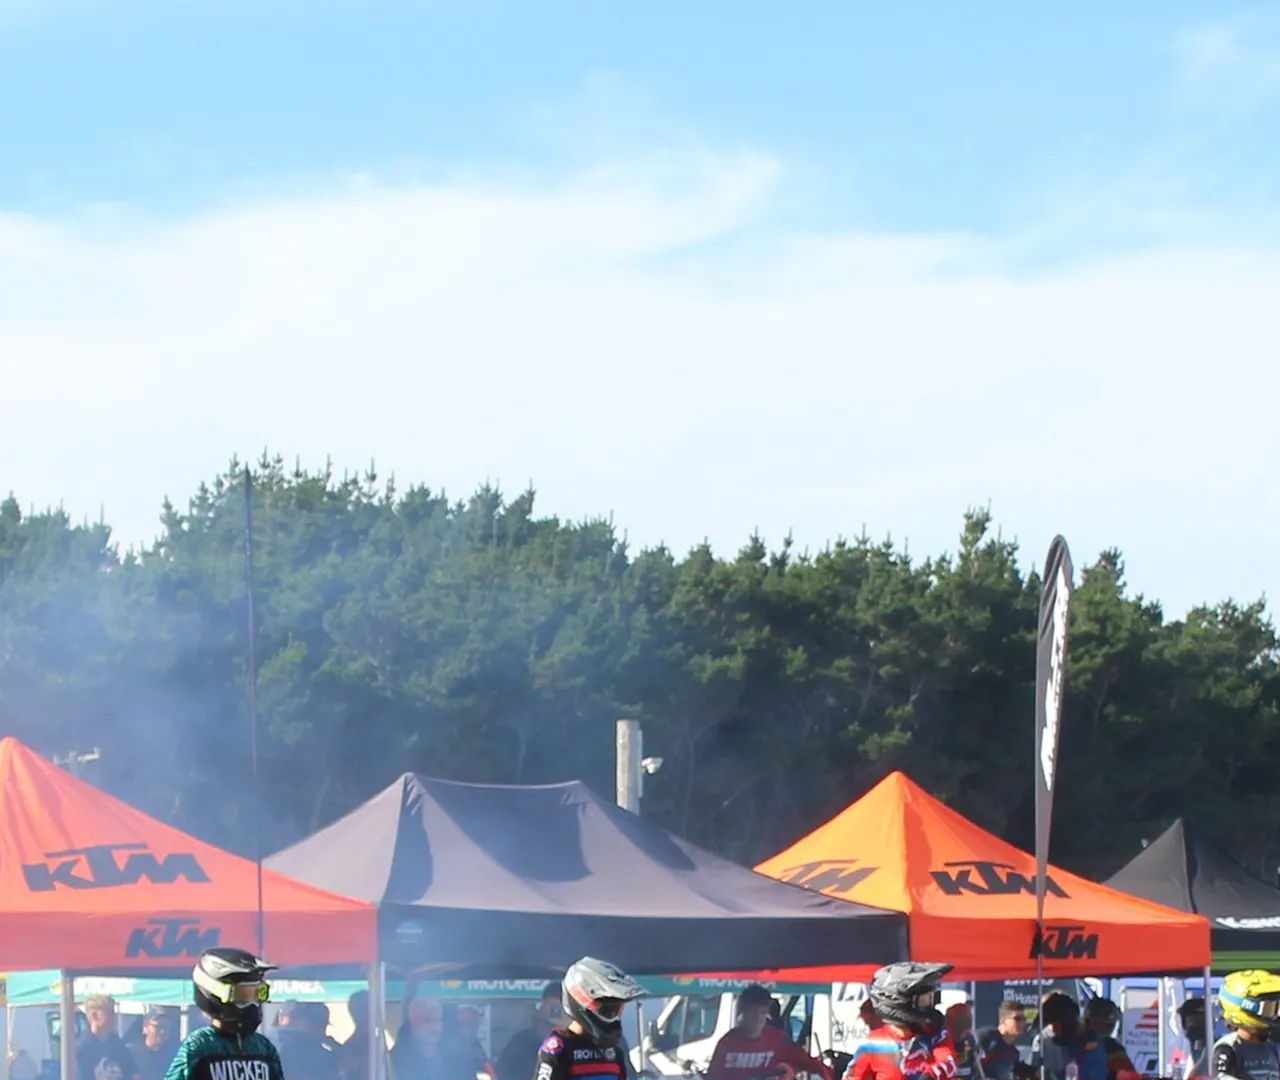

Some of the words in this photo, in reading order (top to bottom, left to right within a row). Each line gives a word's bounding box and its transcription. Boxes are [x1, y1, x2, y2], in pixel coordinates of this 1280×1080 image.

[21, 842, 211, 892] KTM
[930, 861, 1072, 899] KTM
[125, 918, 221, 968] KTM
[1029, 925, 1099, 960] KTM
[724, 1052, 775, 1069] SHIFT
